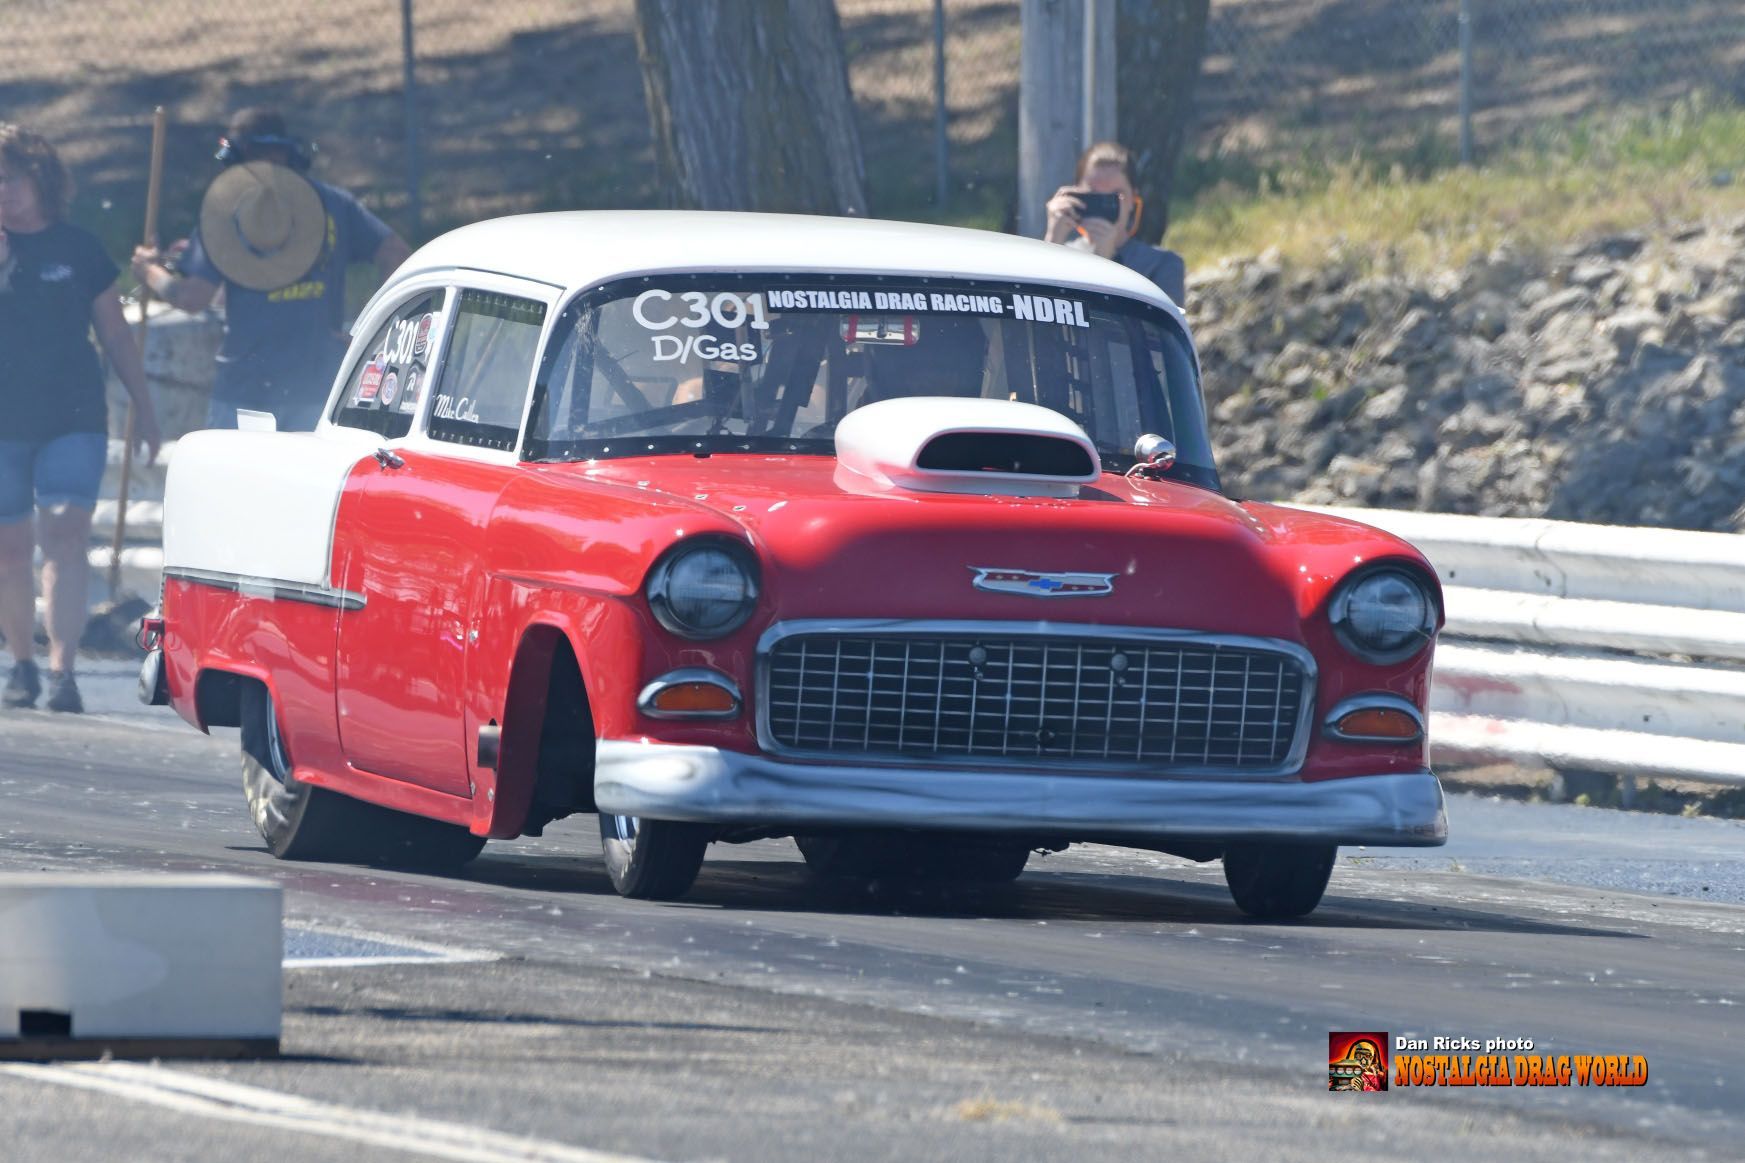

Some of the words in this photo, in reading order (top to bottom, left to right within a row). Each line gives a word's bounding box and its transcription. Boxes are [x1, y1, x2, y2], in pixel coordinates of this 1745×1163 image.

[632, 289, 769, 331] C301
[768, 290, 873, 310] NOSTALGIA
[875, 293, 927, 312] DRAG
[931, 294, 1003, 314] RACING
[652, 335, 758, 364] D/Gas
